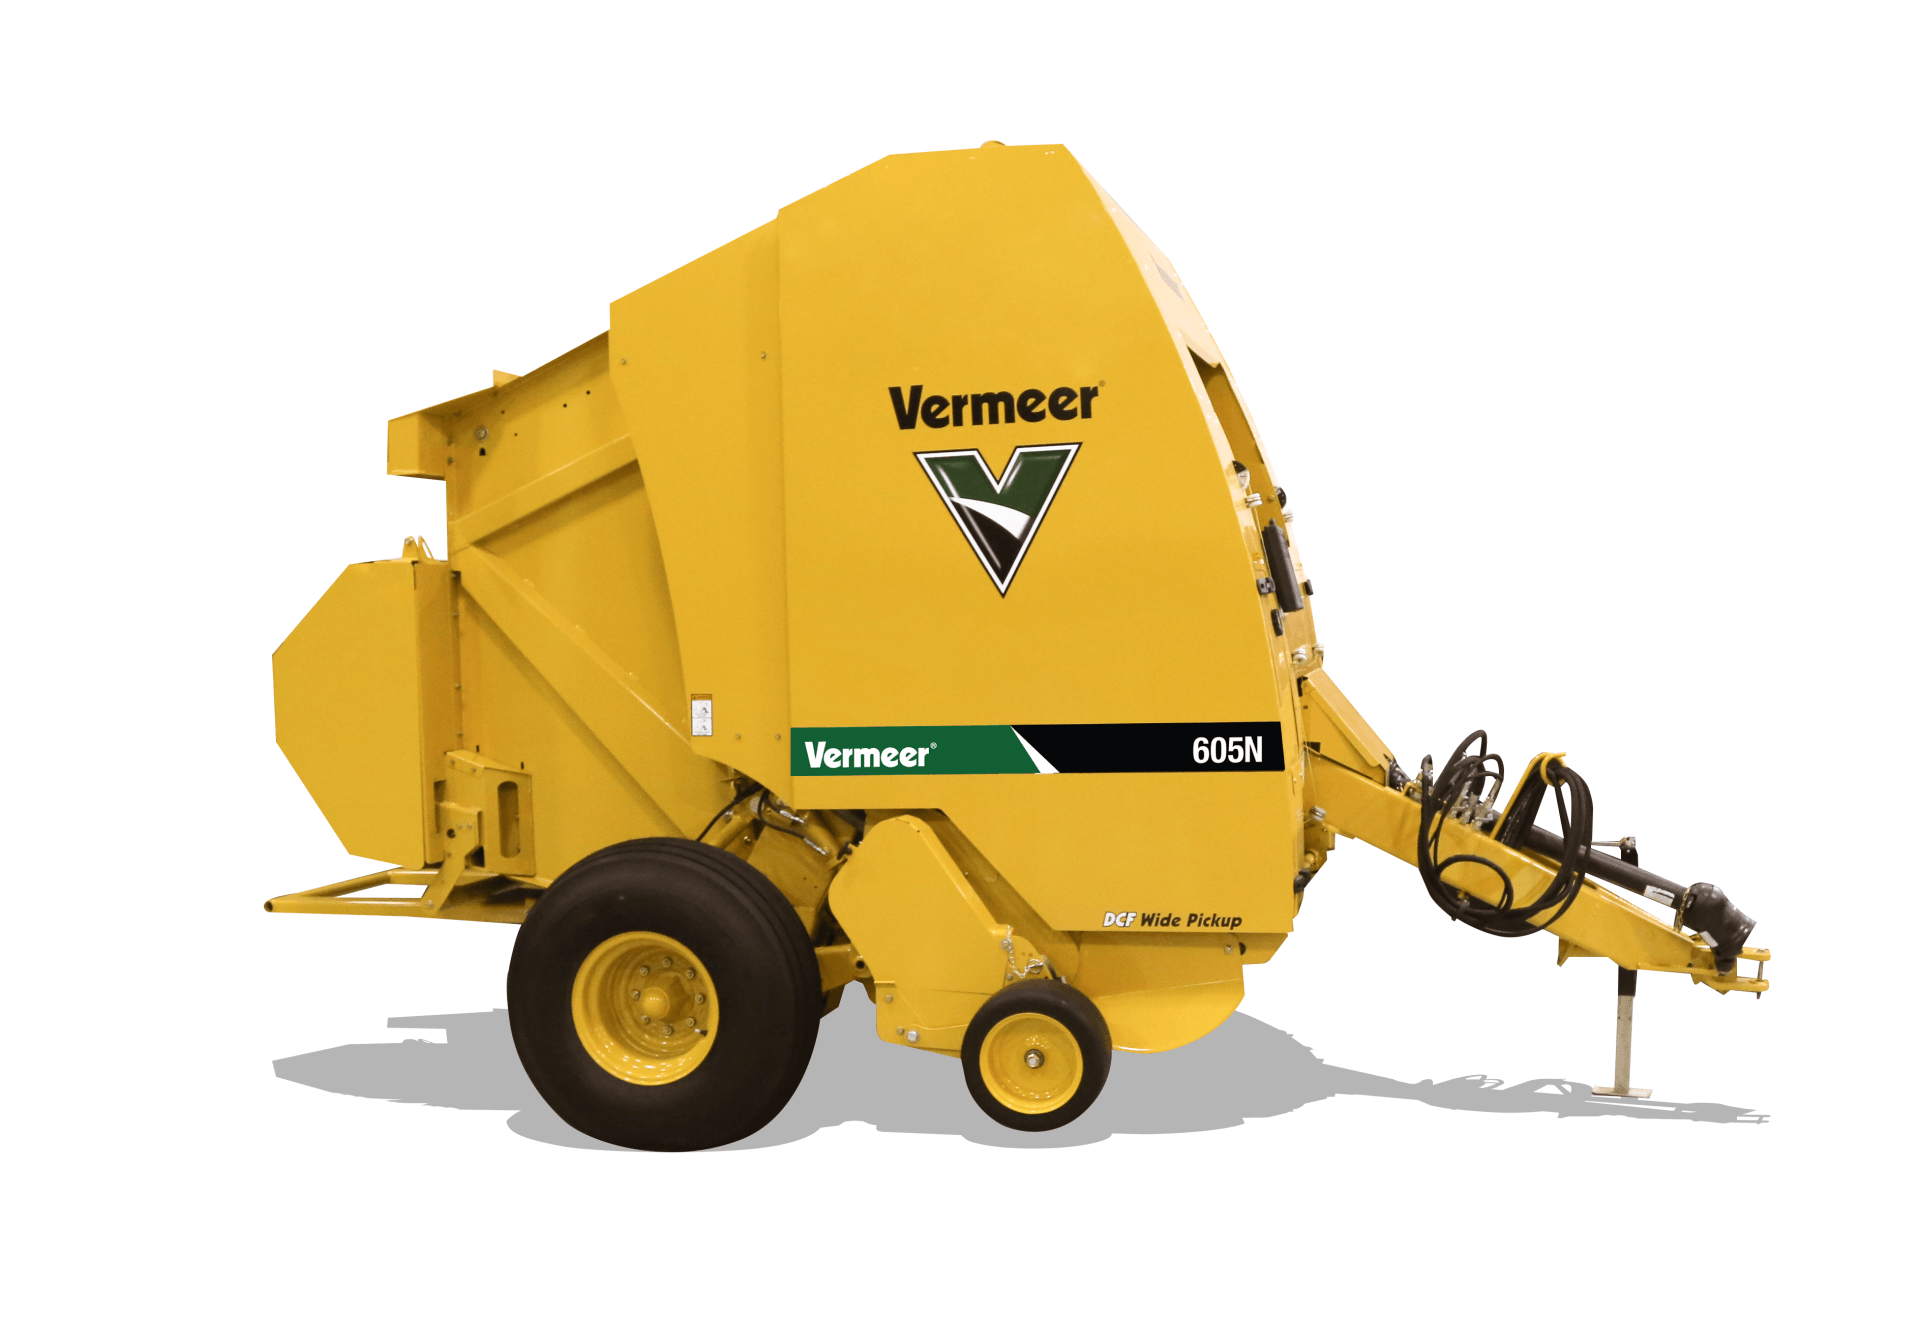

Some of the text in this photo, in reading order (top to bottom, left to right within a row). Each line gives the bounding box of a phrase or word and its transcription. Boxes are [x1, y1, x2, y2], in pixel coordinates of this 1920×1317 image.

[888, 384, 1099, 430] Vermeer
[1192, 736, 1263, 764] 605N
[1102, 911, 1243, 930] DCF Wide Pickup
